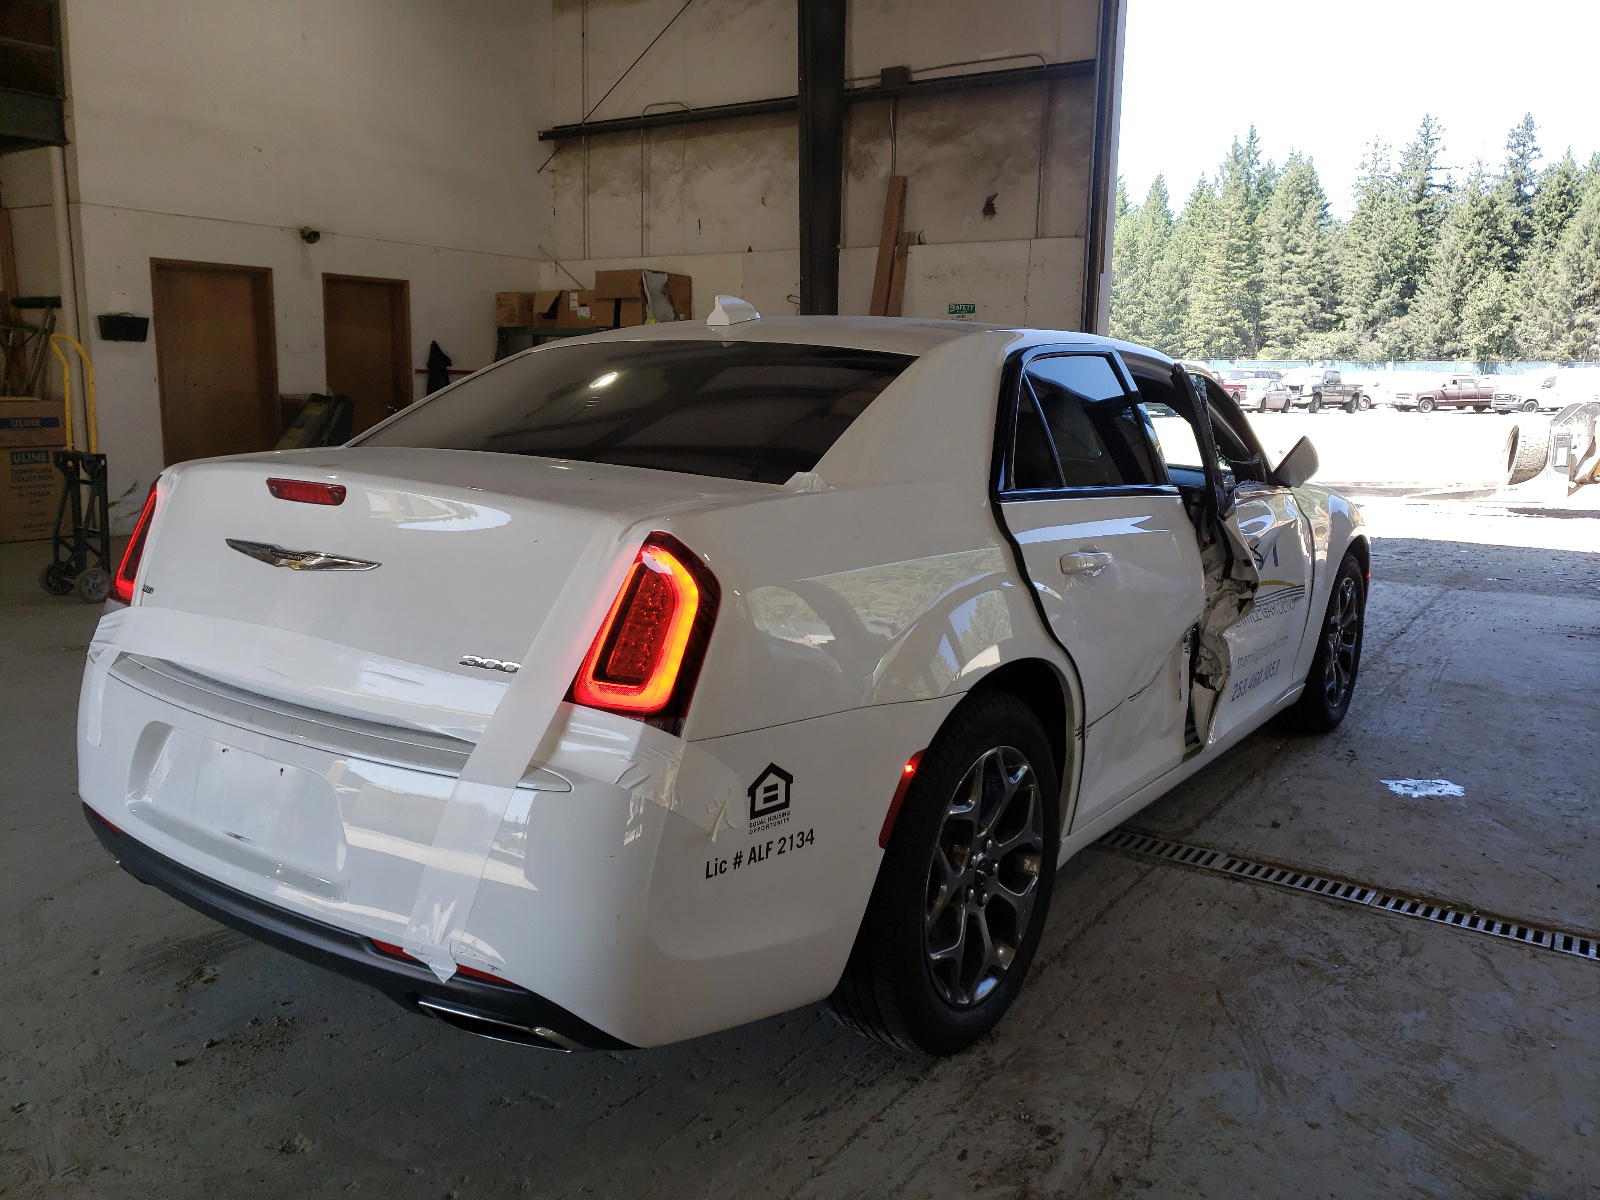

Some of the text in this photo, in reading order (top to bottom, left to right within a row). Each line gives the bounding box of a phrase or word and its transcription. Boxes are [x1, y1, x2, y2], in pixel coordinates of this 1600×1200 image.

[949, 304, 975, 312] SAFETY
[13, 451, 50, 464] ULINE
[459, 655, 521, 673] 300
[748, 817, 790, 835] OPPORTUNITY
[750, 811, 791, 828] EQUAL HOUSING
[705, 828, 815, 879] Lic # ALF 2134
